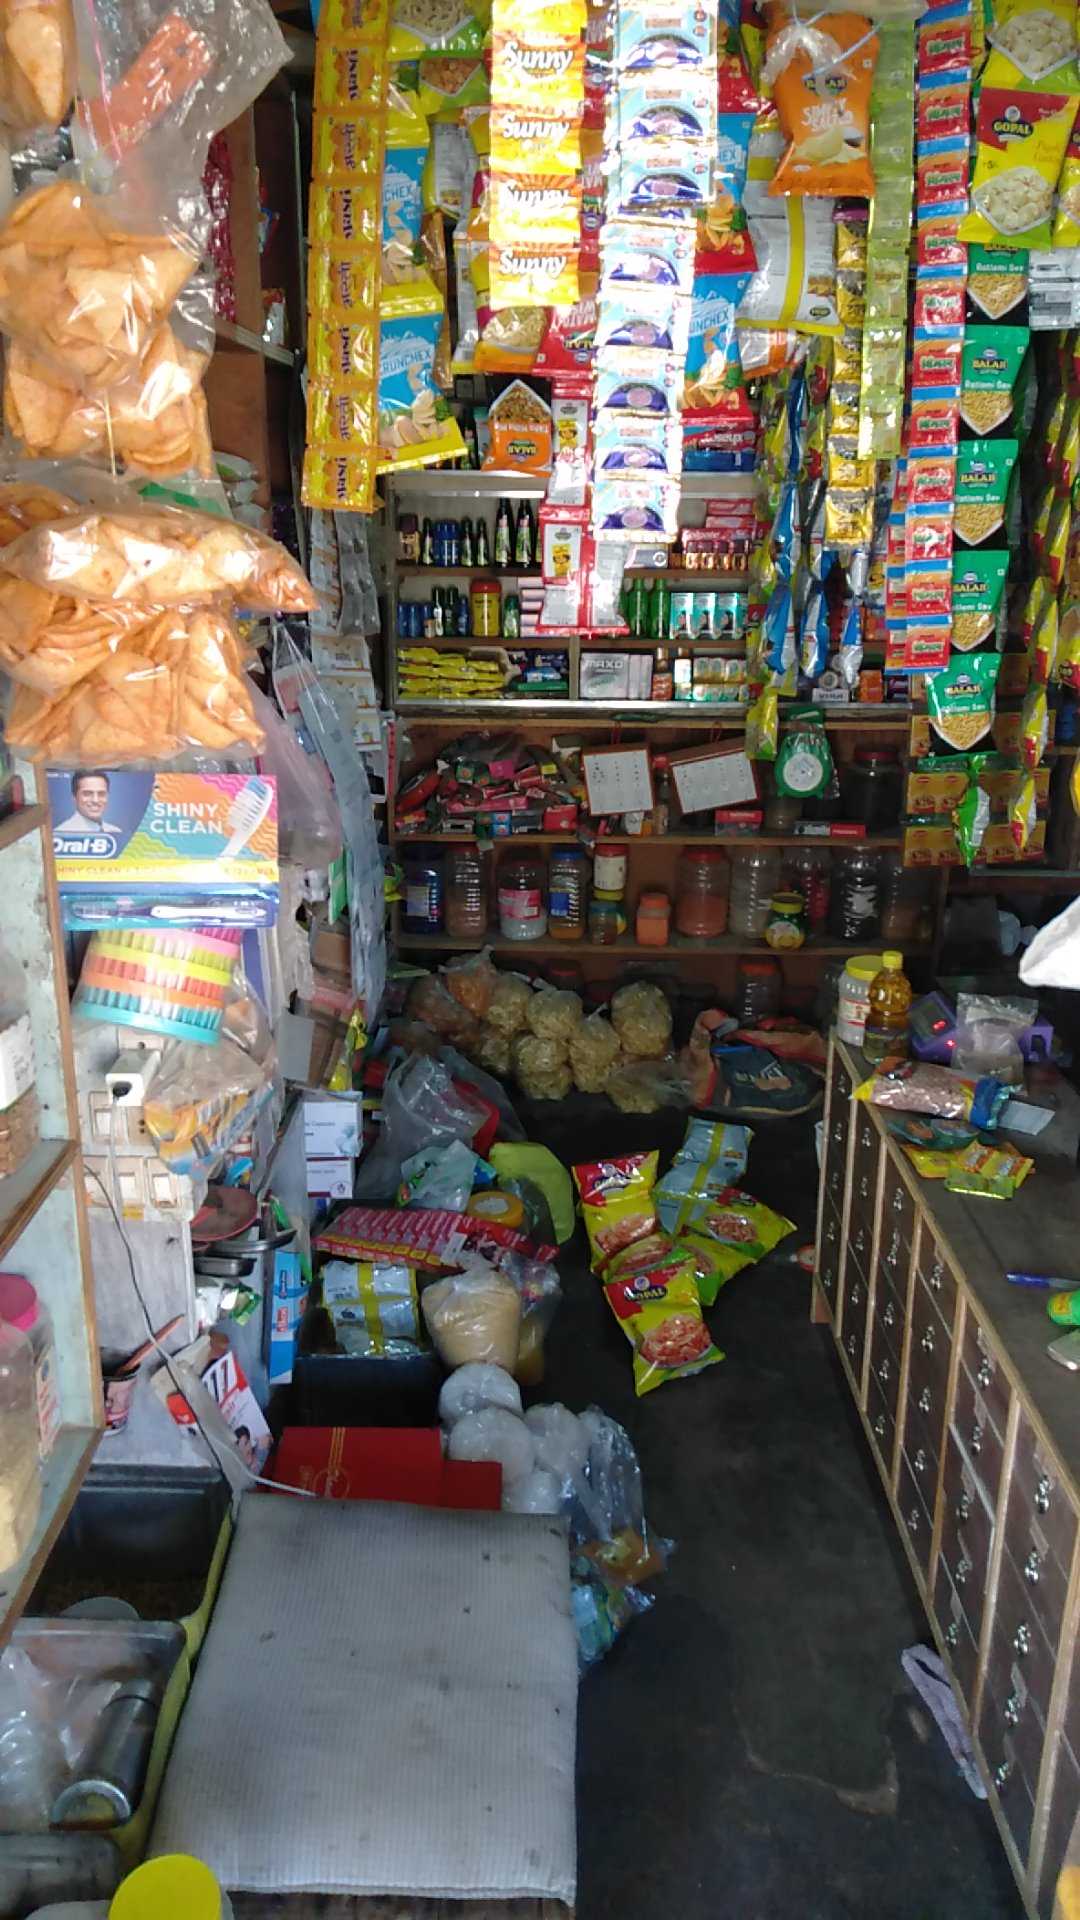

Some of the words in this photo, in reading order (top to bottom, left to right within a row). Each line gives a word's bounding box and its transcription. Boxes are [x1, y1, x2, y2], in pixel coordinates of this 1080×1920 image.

[500, 41, 574, 76] Sunny
[502, 113, 570, 145] Sunny
[993, 121, 1031, 134] GOPAL
[501, 182, 570, 214] Sunny
[499, 250, 568, 280] Sunny
[971, 359, 1008, 369] BALAJI
[960, 473, 996, 483] BALAJI
[153, 802, 219, 817] SHINY
[150, 818, 223, 835] CLEAN
[57, 866, 84, 875] HINY
